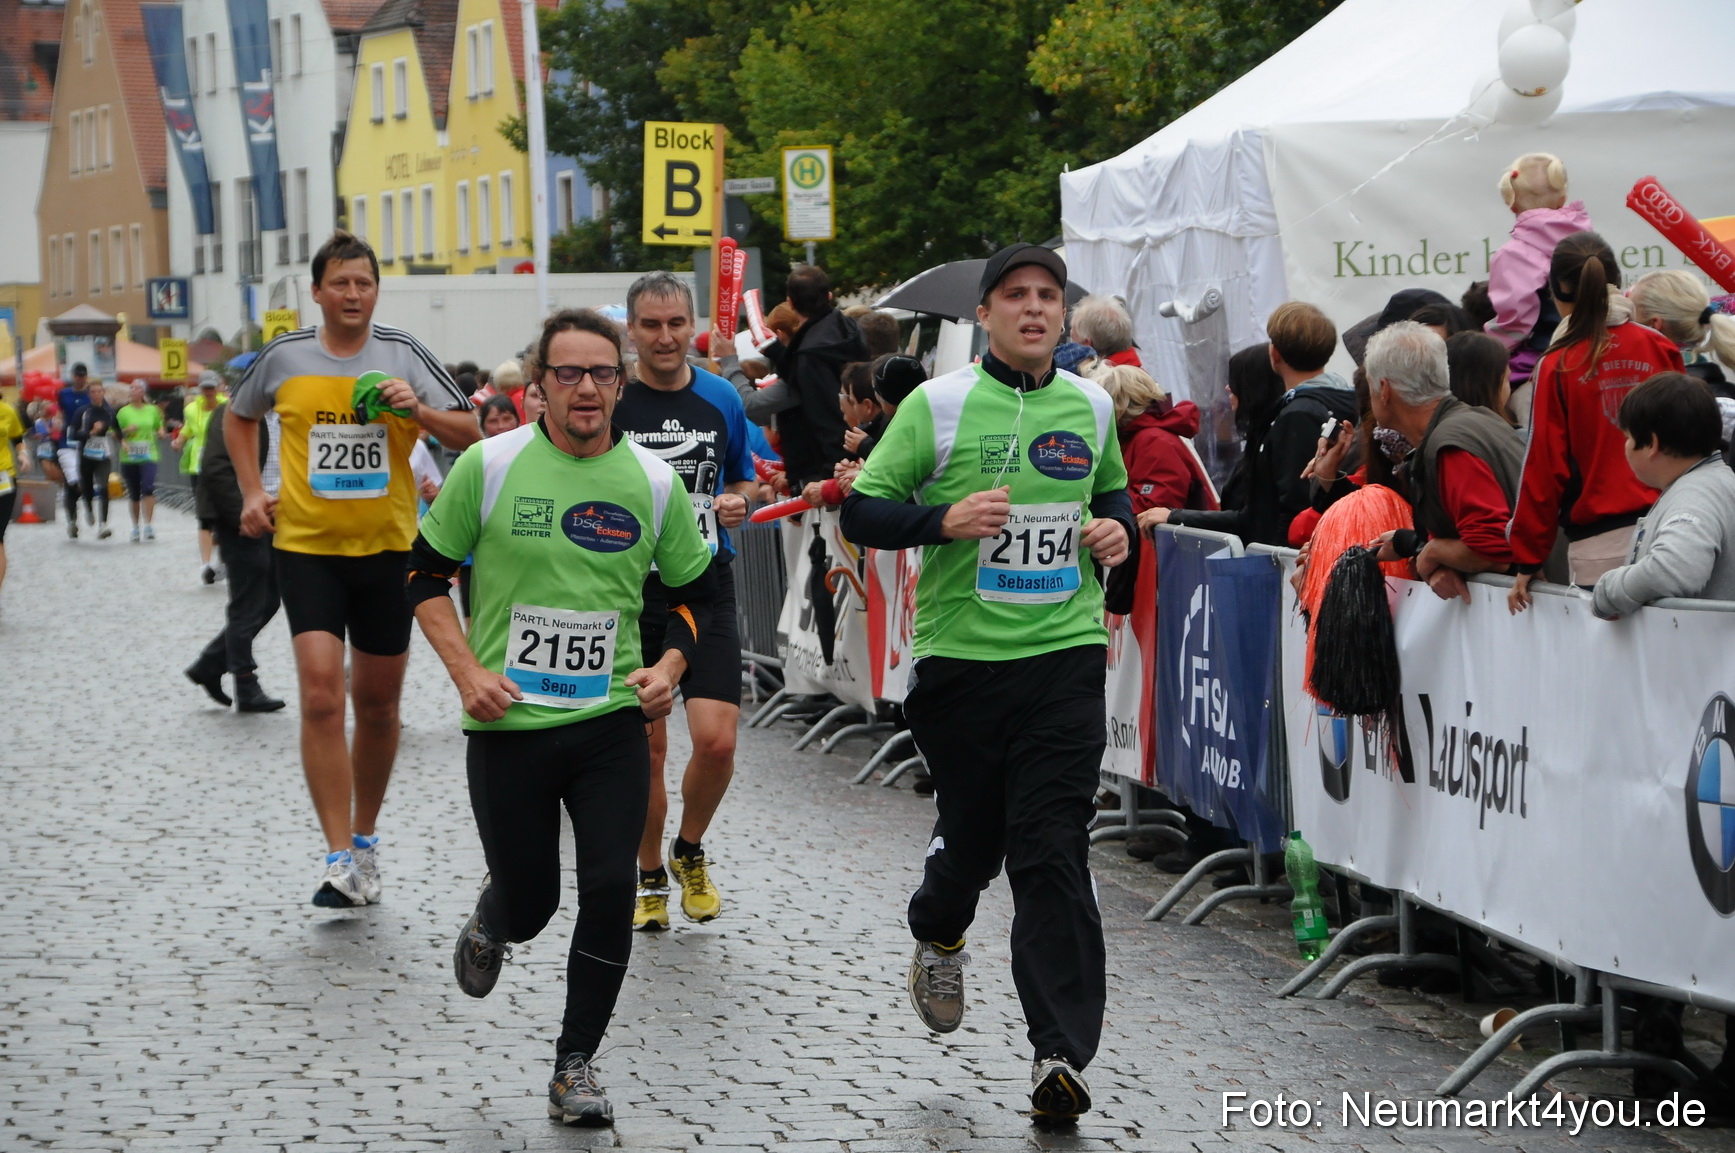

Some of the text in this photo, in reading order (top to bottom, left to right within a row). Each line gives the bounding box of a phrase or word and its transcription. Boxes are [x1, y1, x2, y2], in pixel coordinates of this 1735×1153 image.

[655, 127, 714, 149] Block
[665, 160, 702, 217] B
[1333, 238, 1470, 278] Kinder
[1692, 231, 1732, 270] BKK
[719, 286, 730, 312] BKK
[265, 312, 294, 322] Block
[167, 351, 181, 370] D
[316, 411, 360, 425] FRAN
[662, 419, 684, 431] 40.
[317, 442, 382, 470] 2266
[1062, 454, 1089, 466] Eckstein
[981, 466, 1020, 474] RICHTER
[335, 477, 365, 488] Frank
[515, 496, 554, 505] Karosserie
[512, 521, 552, 529] Fachbetrieb
[1023, 513, 1070, 523] Neumarkt
[511, 529, 551, 538] RICHTER
[596, 526, 632, 539] Eckstein
[990, 527, 1073, 566] 2154
[997, 574, 1064, 589] Sebastian
[513, 612, 602, 630] PARTL Neumarkt
[517, 629, 606, 671] 2155
[541, 678, 577, 698] Sepp
[1201, 745, 1246, 790] AUTOB
